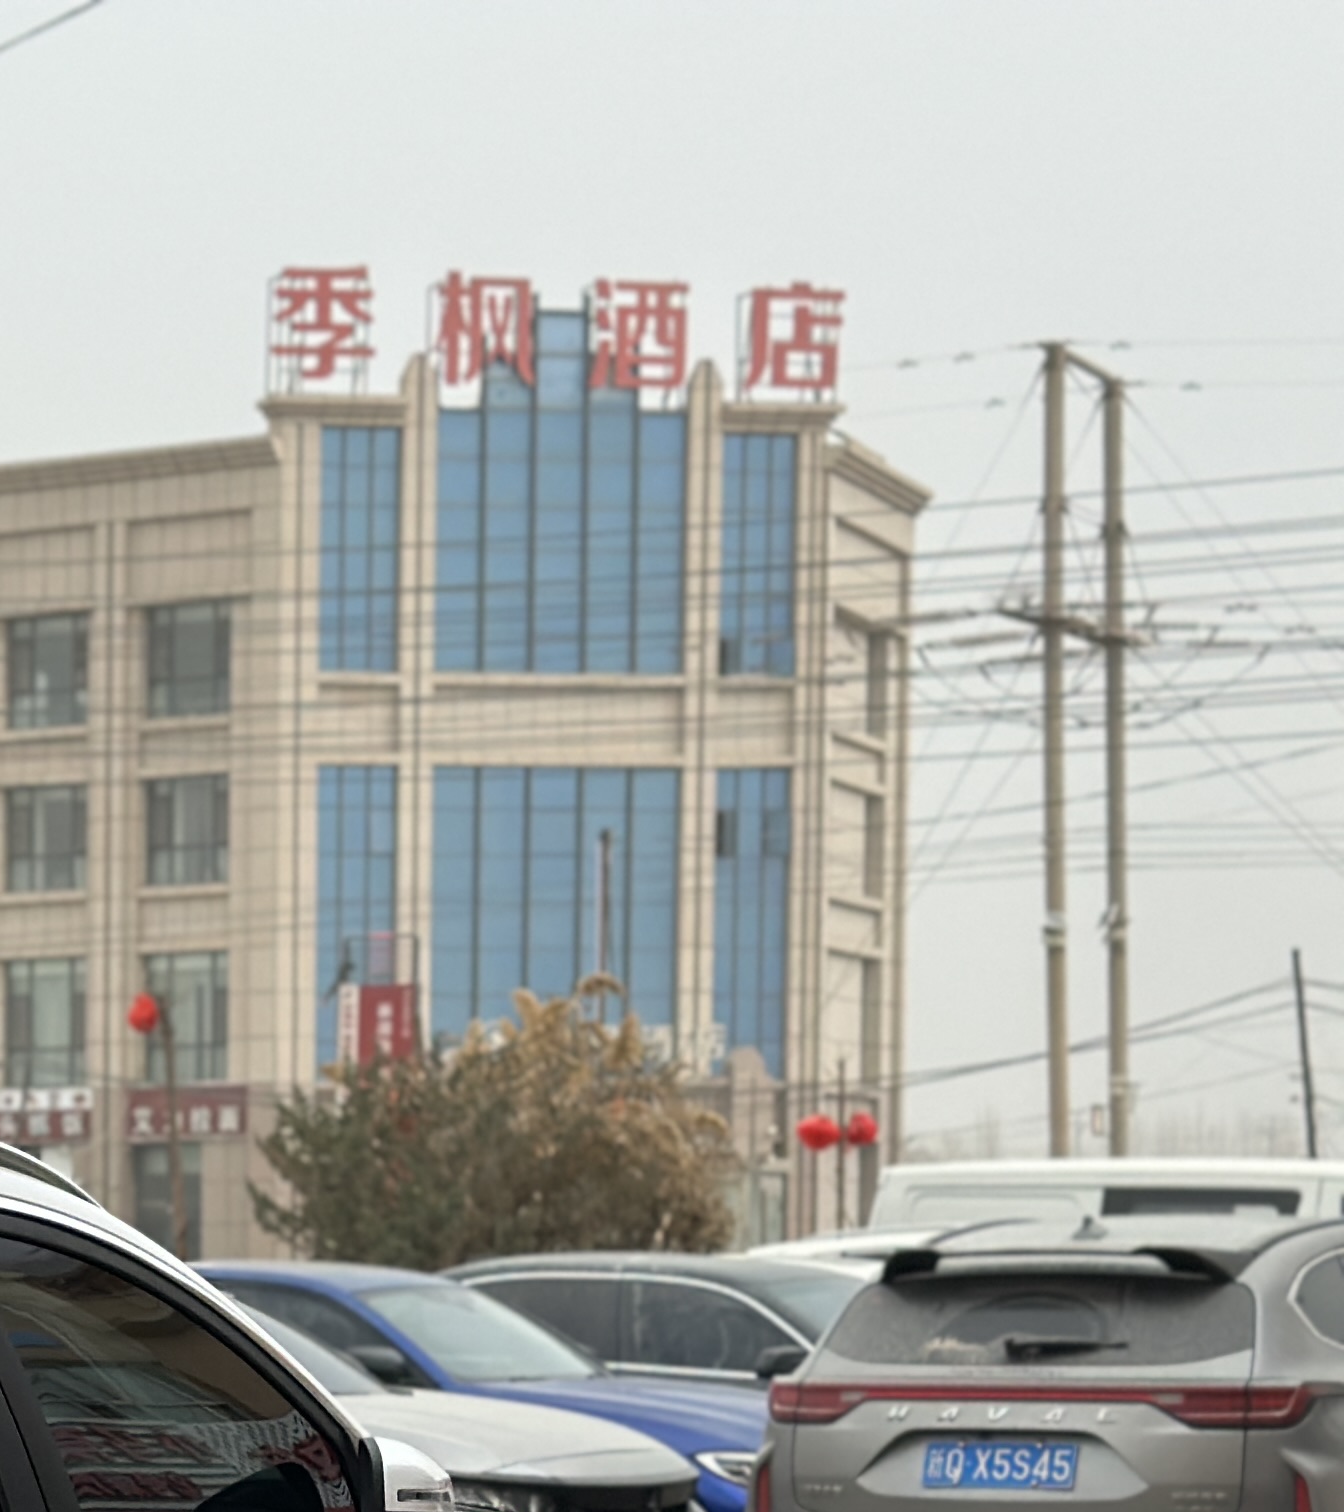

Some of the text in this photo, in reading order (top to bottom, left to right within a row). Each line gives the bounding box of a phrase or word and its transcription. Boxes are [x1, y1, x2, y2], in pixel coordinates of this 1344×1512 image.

[269, 265, 846, 390] 季枫酒店
[887, 1405, 1115, 1424] HAVAL
